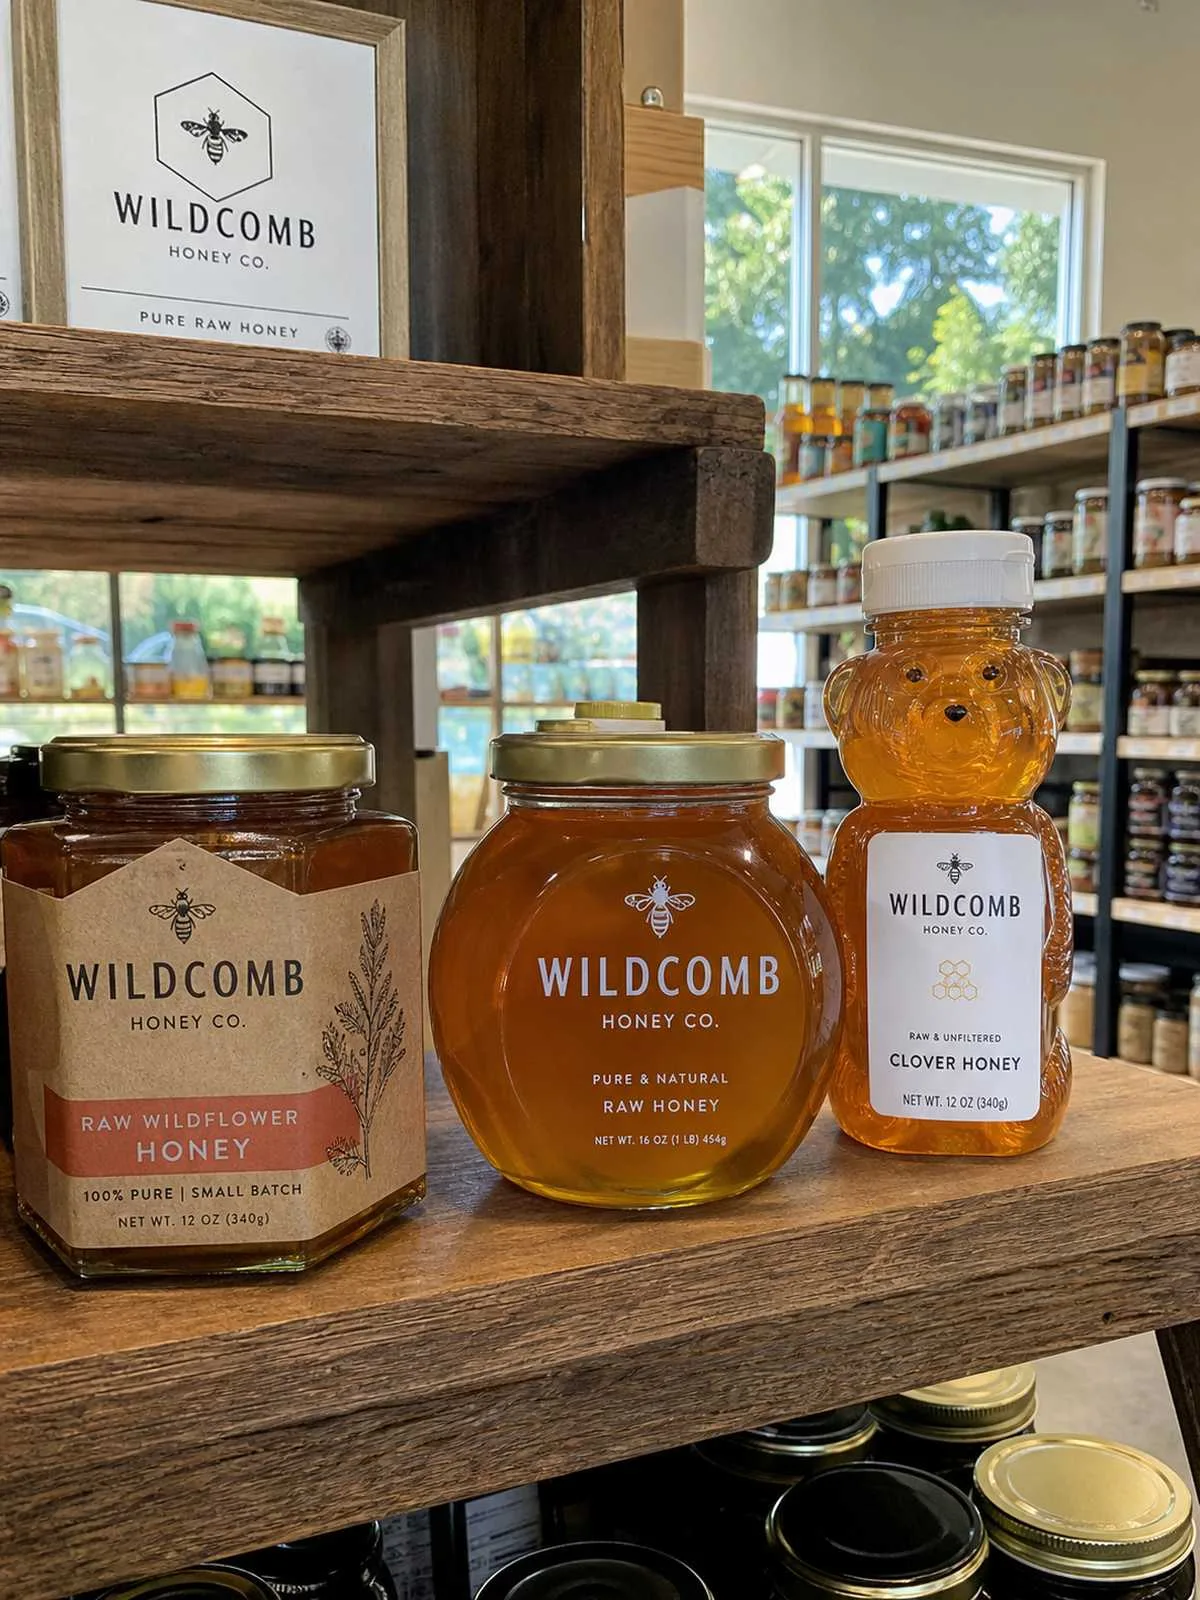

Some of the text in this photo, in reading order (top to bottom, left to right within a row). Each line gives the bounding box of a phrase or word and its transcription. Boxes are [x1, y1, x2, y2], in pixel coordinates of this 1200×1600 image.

[114, 191, 315, 248] WILDCOMB
[168, 245, 270, 270] HONEY CO.
[139, 311, 299, 339] PURE RAW HONEY
[889, 893, 1021, 918] WILDCOMB
[923, 926, 988, 936] HONEY CO.
[65, 959, 305, 1001] WILDCOMB
[537, 955, 780, 997] WILDCOMB
[130, 1014, 246, 1031] HONEY CO.
[602, 1013, 719, 1029] HONEY CO.
[909, 1032, 1002, 1043] RAW & UNFILTERED
[889, 1053, 1022, 1071] CLOVER HONEY
[592, 1073, 729, 1085] PURE & NATURAL
[603, 1099, 720, 1113] RAW HONEY
[903, 1094, 1008, 1110] NET WT. 12 OZ (340g)
[80, 1110, 299, 1133] RAW WILDFLOWER
[594, 1136, 615, 1145] NET
[617, 1136, 635, 1145] WT.
[639, 1135, 650, 1145] 16
[654, 1135, 668, 1145] OZ
[683, 1134, 699, 1146] LB)
[703, 1134, 727, 1147] 454g
[136, 1138, 252, 1164] HONEY
[83, 1188, 124, 1203] 100%
[130, 1186, 174, 1201] PURE
[191, 1185, 244, 1199] SMALL
[250, 1183, 303, 1198] BATCH
[118, 1212, 270, 1229] NET WT. 12 OZ (340g)
